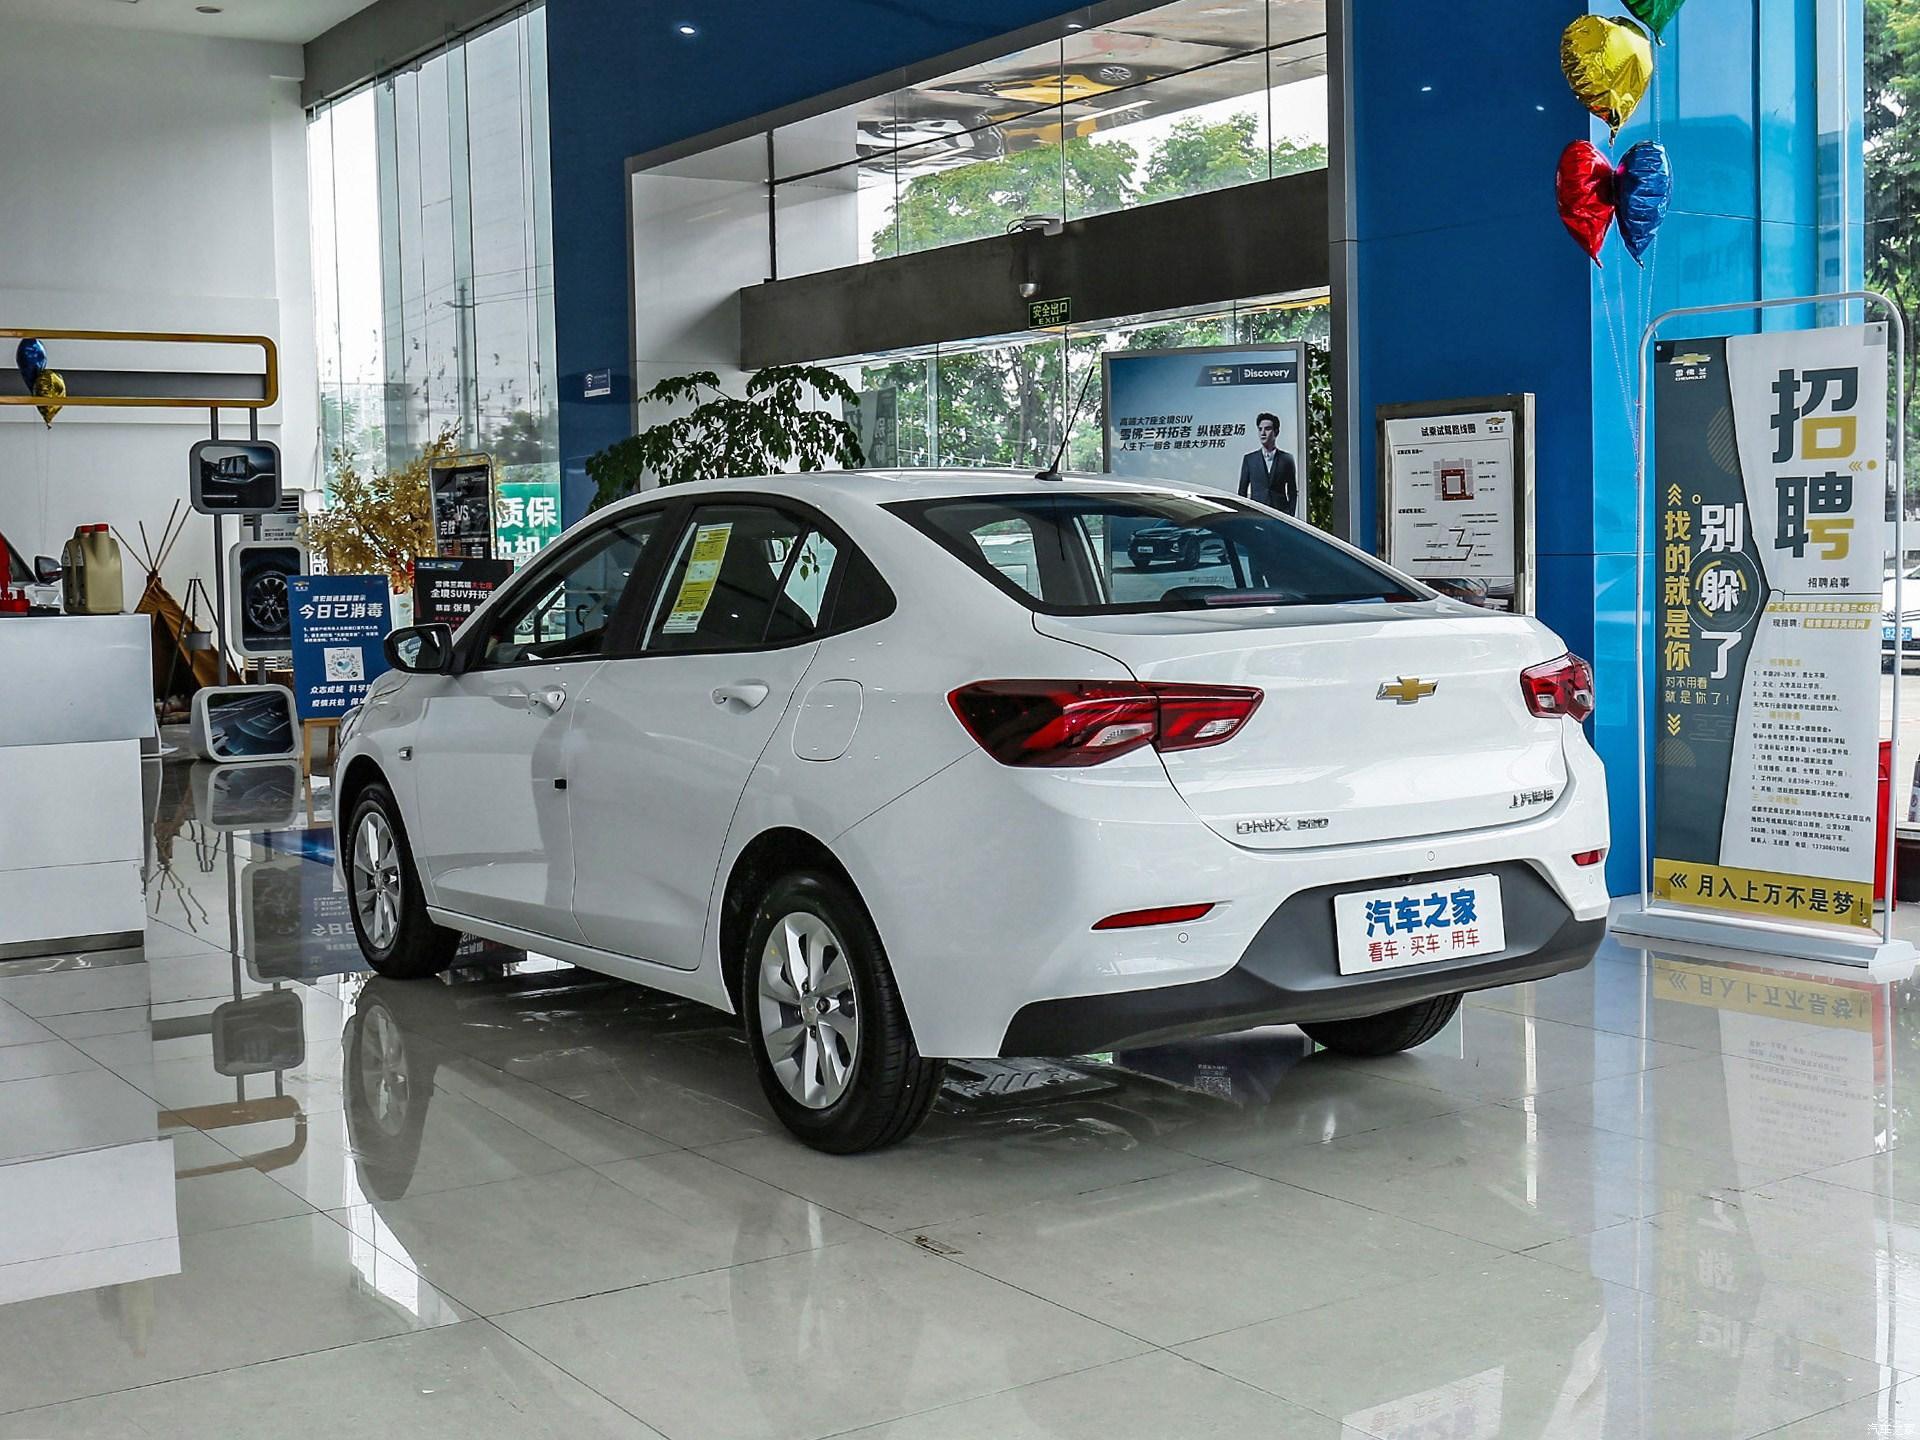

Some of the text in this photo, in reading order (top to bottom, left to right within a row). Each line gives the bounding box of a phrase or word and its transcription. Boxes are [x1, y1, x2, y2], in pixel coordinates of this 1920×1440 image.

[1033, 302, 1067, 318] 安全出口
[1039, 316, 1061, 325] EXIT
[1244, 368, 1290, 379] Discovery
[1119, 424, 1246, 441] 雪佛兰开拓者 纵横登场
[1421, 424, 1476, 436] 试乘试驾路线图
[1119, 439, 1226, 451] 人生下一回合 继续大步开拓
[1770, 367, 1859, 561] 招聘
[1807, 577, 1850, 589] 招聘启事
[1664, 511, 1692, 672] 找的就是你
[1700, 503, 1744, 680] 别躲了
[299, 602, 383, 619] 今日已消毒
[1366, 888, 1477, 938] 汽车之家
